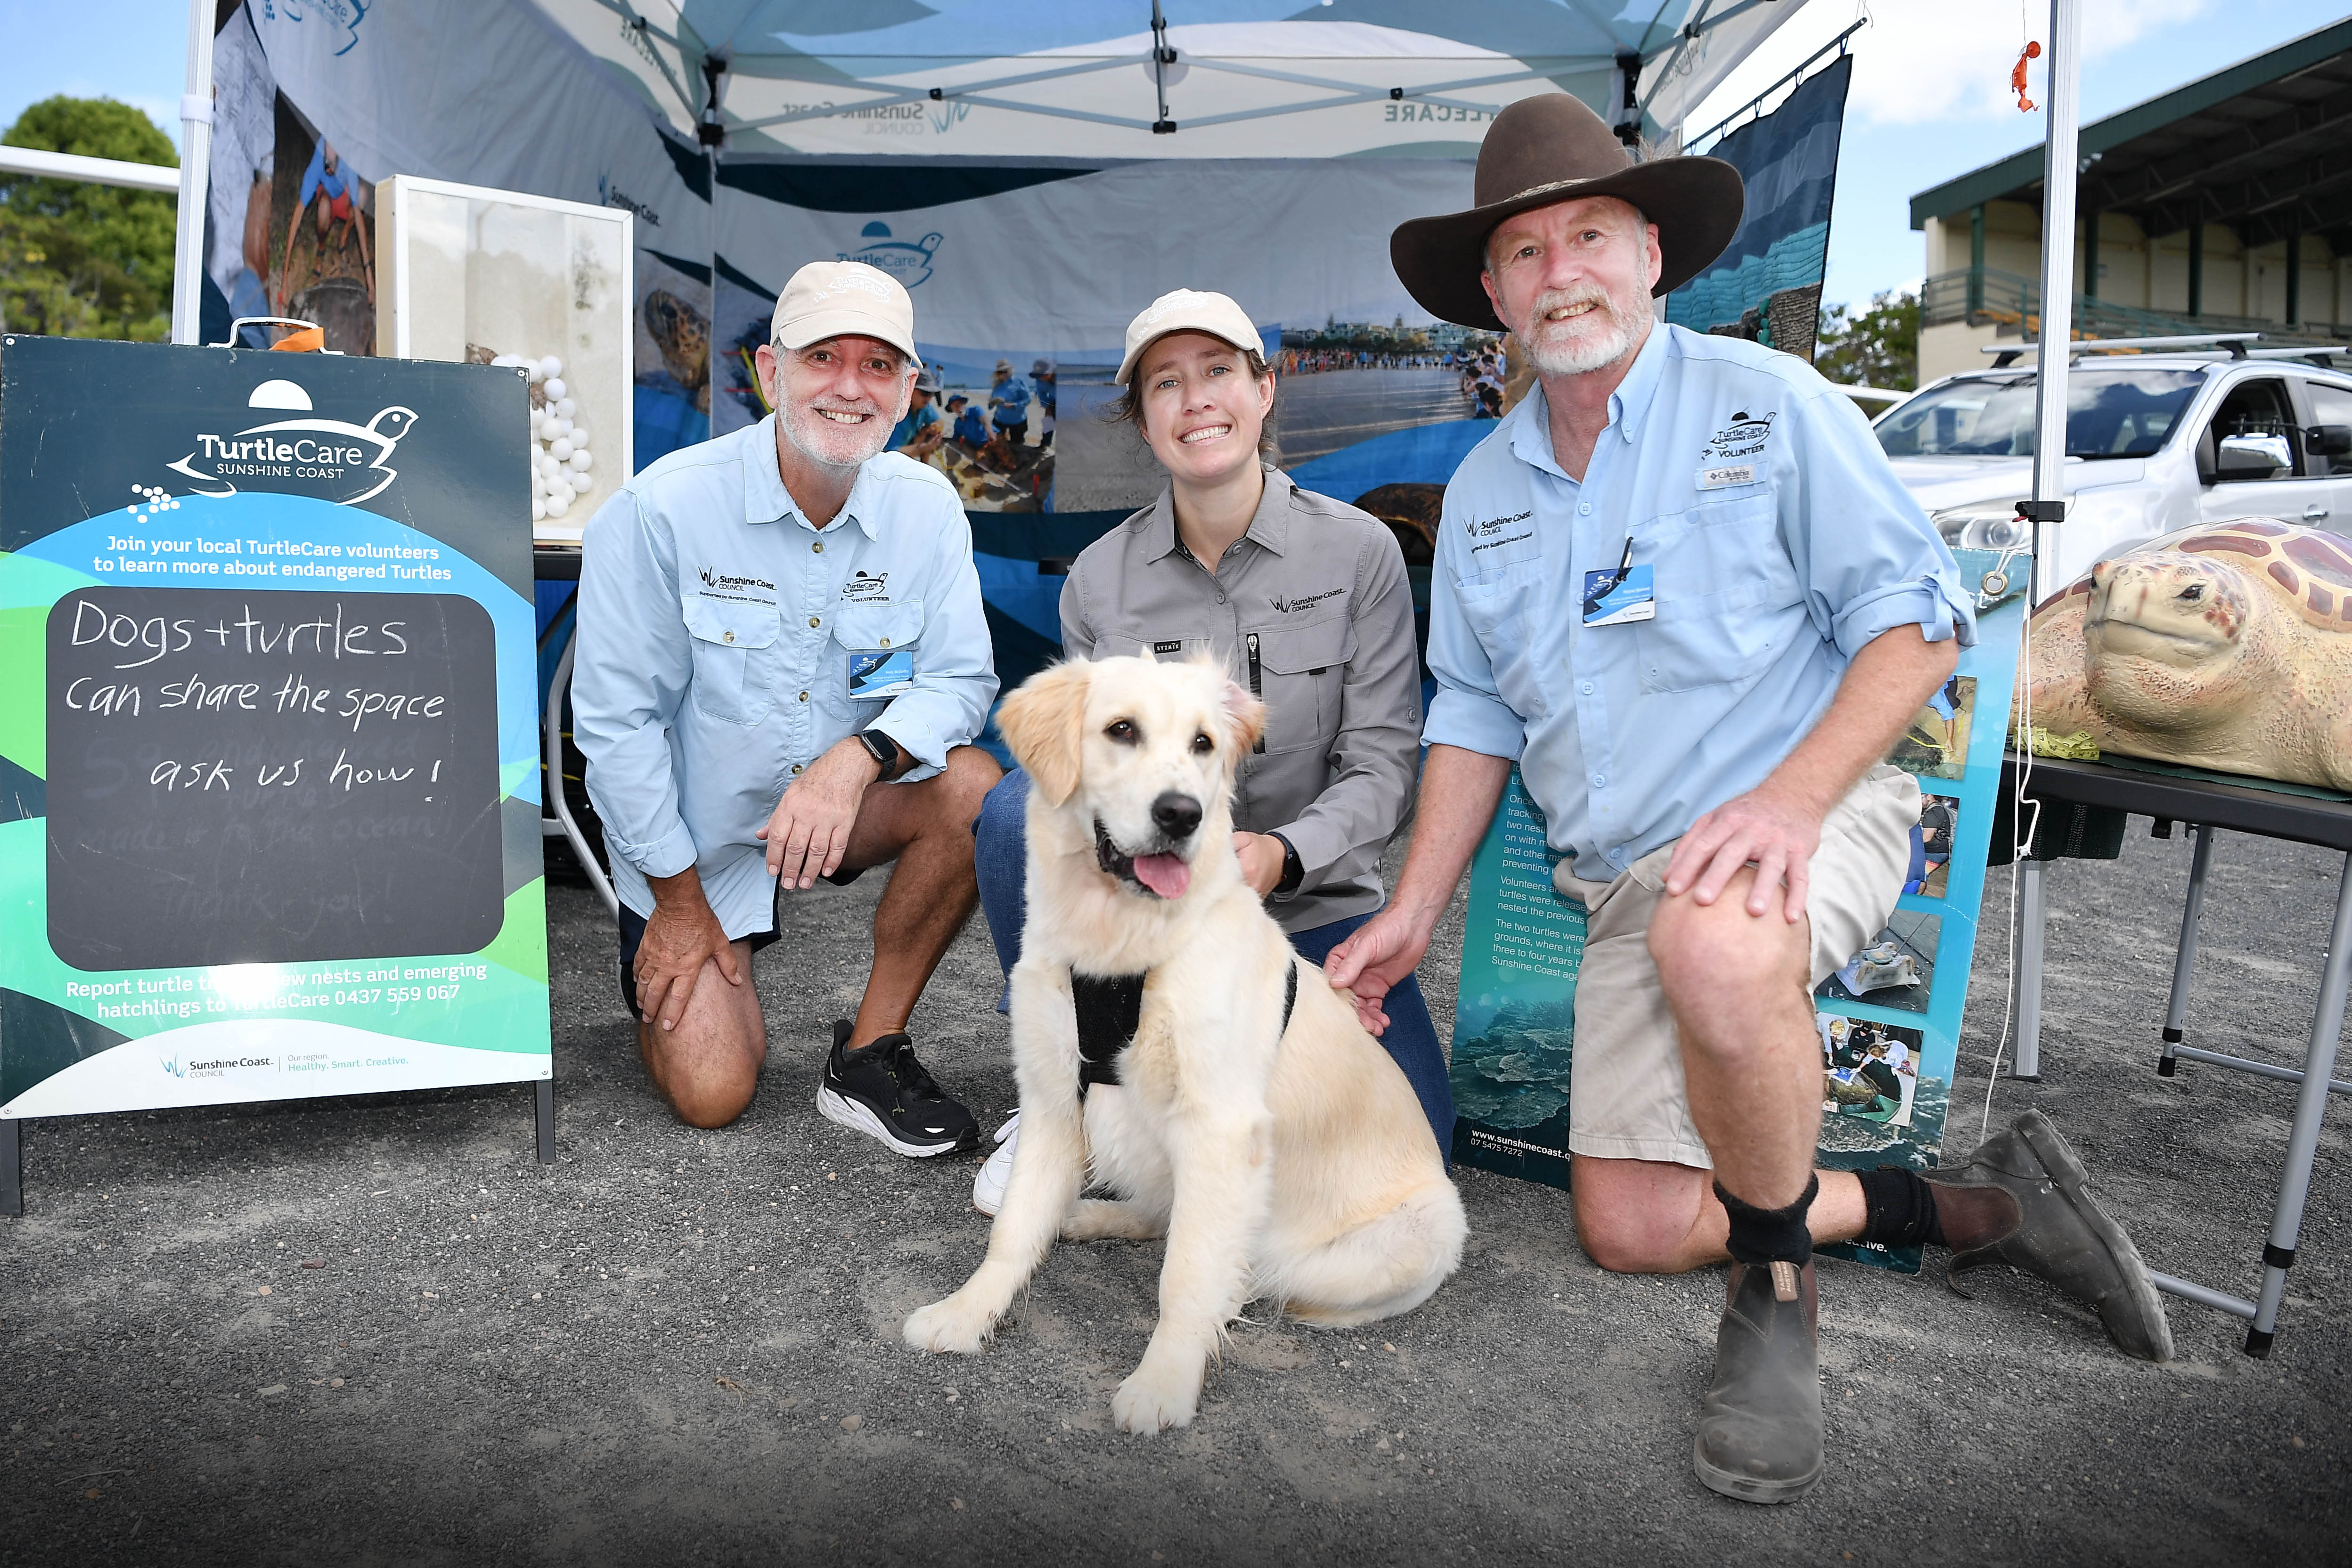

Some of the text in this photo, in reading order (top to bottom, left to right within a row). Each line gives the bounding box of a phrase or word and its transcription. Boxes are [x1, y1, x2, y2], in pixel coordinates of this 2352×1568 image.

[1717, 427, 1763, 438] TurtleCare
[197, 434, 363, 466] TurtleCare
[1719, 444, 1765, 458] VOLUNTEER
[216, 463, 344, 479] SUNSHINE COAST
[1481, 516, 1512, 530] Sunshine
[107, 535, 440, 560] Join your local TurtleCare volunteers
[93, 556, 452, 581] to learn more about endangered Turtles
[719, 575, 756, 586] Sunshine
[719, 583, 745, 591] COUNCIL
[1290, 595, 1323, 607] Sunshine
[1291, 603, 1316, 612] COUNCIL
[71, 599, 196, 669] Dogs
[159, 673, 261, 712] share
[272, 673, 331, 713] the
[338, 688, 445, 732] space
[150, 759, 234, 792] ask
[257, 758, 304, 786] us
[1509, 794, 1534, 806] Once
[1508, 807, 1544, 822] tracking
[1506, 820, 1522, 830] two
[1505, 834, 1517, 842] on
[1519, 836, 1537, 845] with
[1503, 846, 1521, 856] and
[1523, 849, 1546, 860] other
[1502, 859, 1549, 875] preventing
[1500, 875, 1547, 892] Volunteers
[1499, 888, 1527, 901] turtles
[1528, 895, 1551, 905] were
[1497, 902, 1585, 924] nested the previous
[1496, 918, 1585, 943] The two turtles were
[1494, 932, 1581, 956] grounds, where it is
[1493, 944, 1516, 955] three
[1518, 948, 1527, 957] to
[1528, 950, 1546, 961] four
[1548, 955, 1573, 967] years
[281, 974, 305, 986] ew
[311, 968, 362, 985] nests
[366, 965, 399, 982] and
[404, 963, 488, 982] emerging
[1491, 956, 1532, 971] Sunshine
[1534, 964, 1561, 977] Coast
[66, 979, 133, 1000] Report
[137, 976, 193, 992] turtle
[98, 998, 201, 1018] hatchlings
[206, 999, 227, 1013] to
[335, 988, 382, 1005] 0437
[386, 987, 422, 1003] 559
[426, 984, 460, 1001] 067
[189, 1060, 239, 1070] Sunshine
[288, 1057, 409, 1073] Healthy. Smart. Creative.
[303, 1053, 330, 1063] region.
[190, 1070, 225, 1078] COUNCIL
[1470, 1138, 1523, 1157] 07 5475 7272
